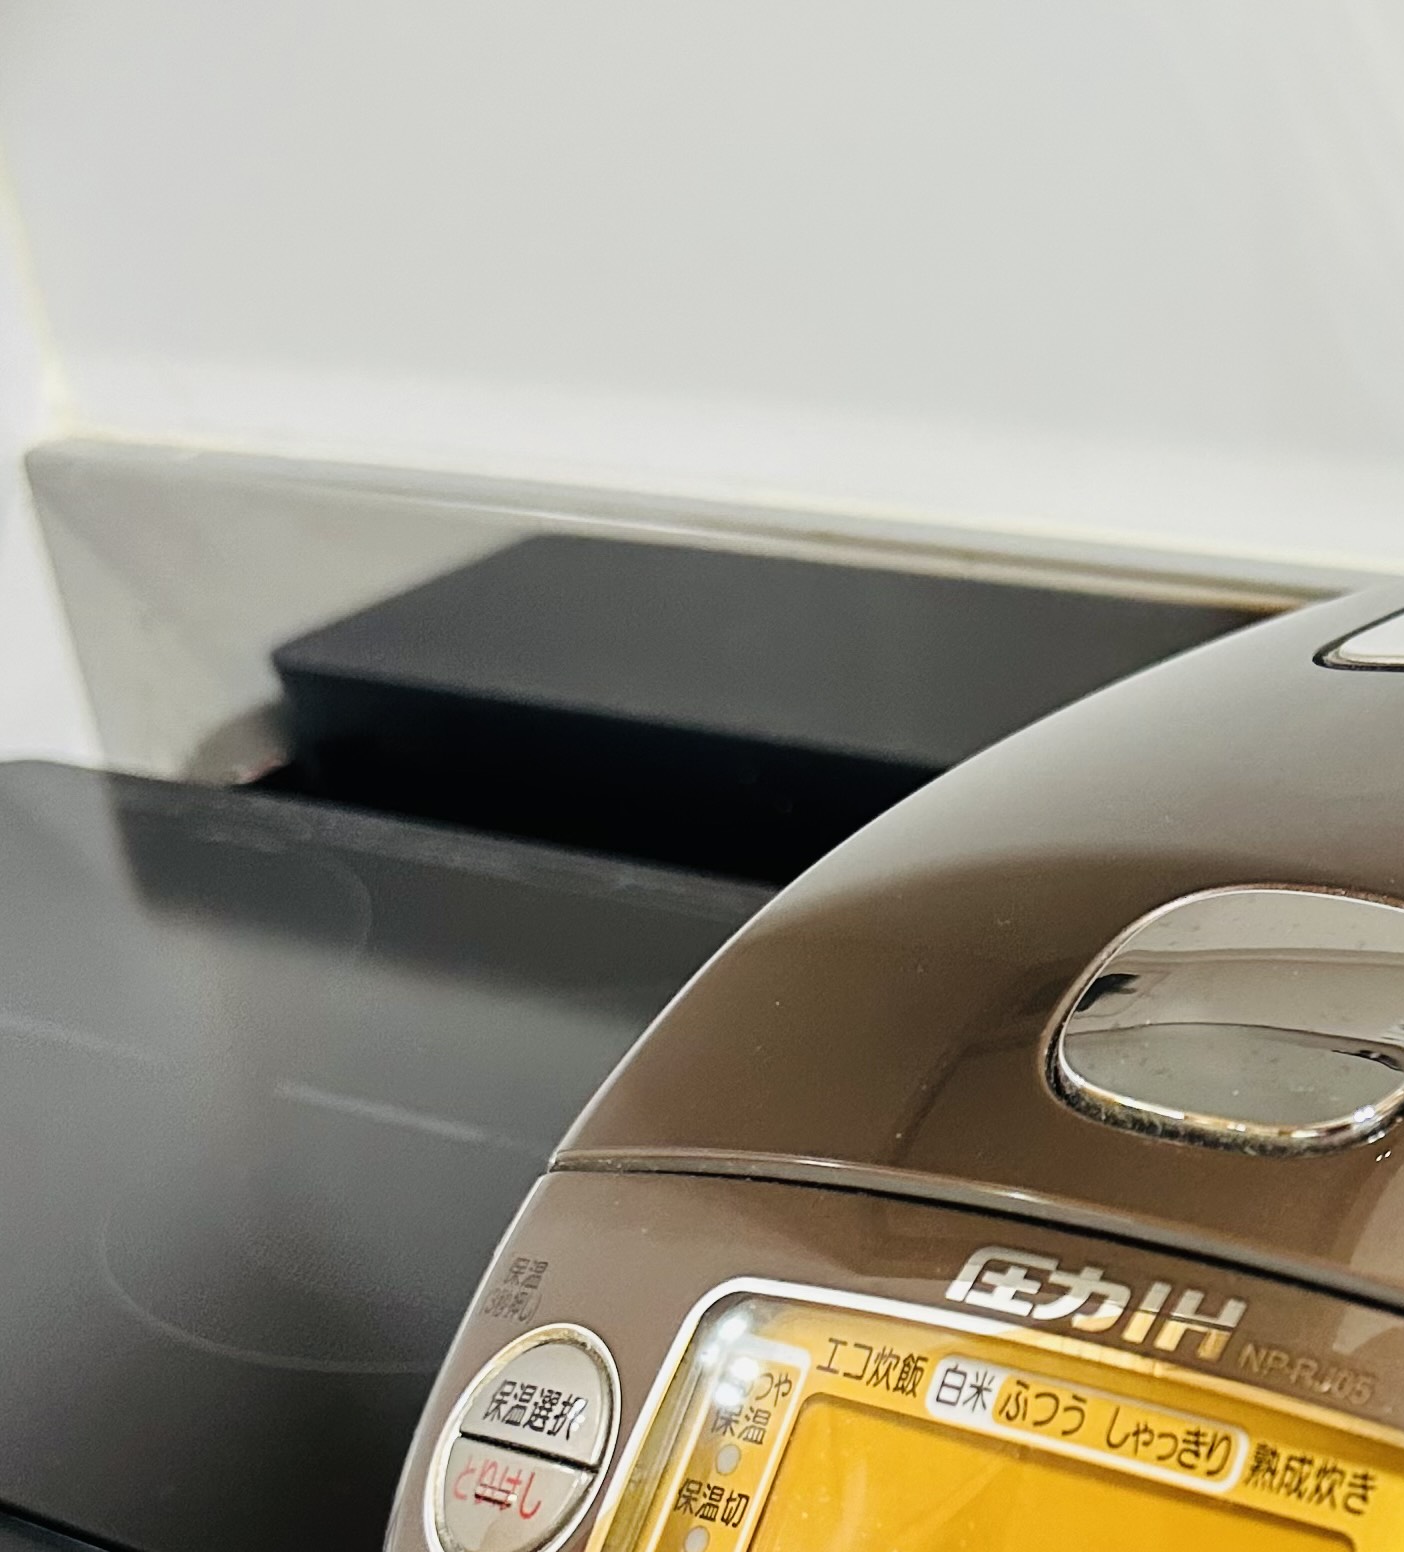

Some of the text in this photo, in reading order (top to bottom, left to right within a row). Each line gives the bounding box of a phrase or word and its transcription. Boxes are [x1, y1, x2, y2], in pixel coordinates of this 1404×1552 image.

[945, 1246, 1247, 1361] 圧力IH
[816, 1337, 1376, 1515] エコ炊飯 白米 ふつう しゃっきり 熟成炊き
[673, 1478, 750, 1529] 保温切
